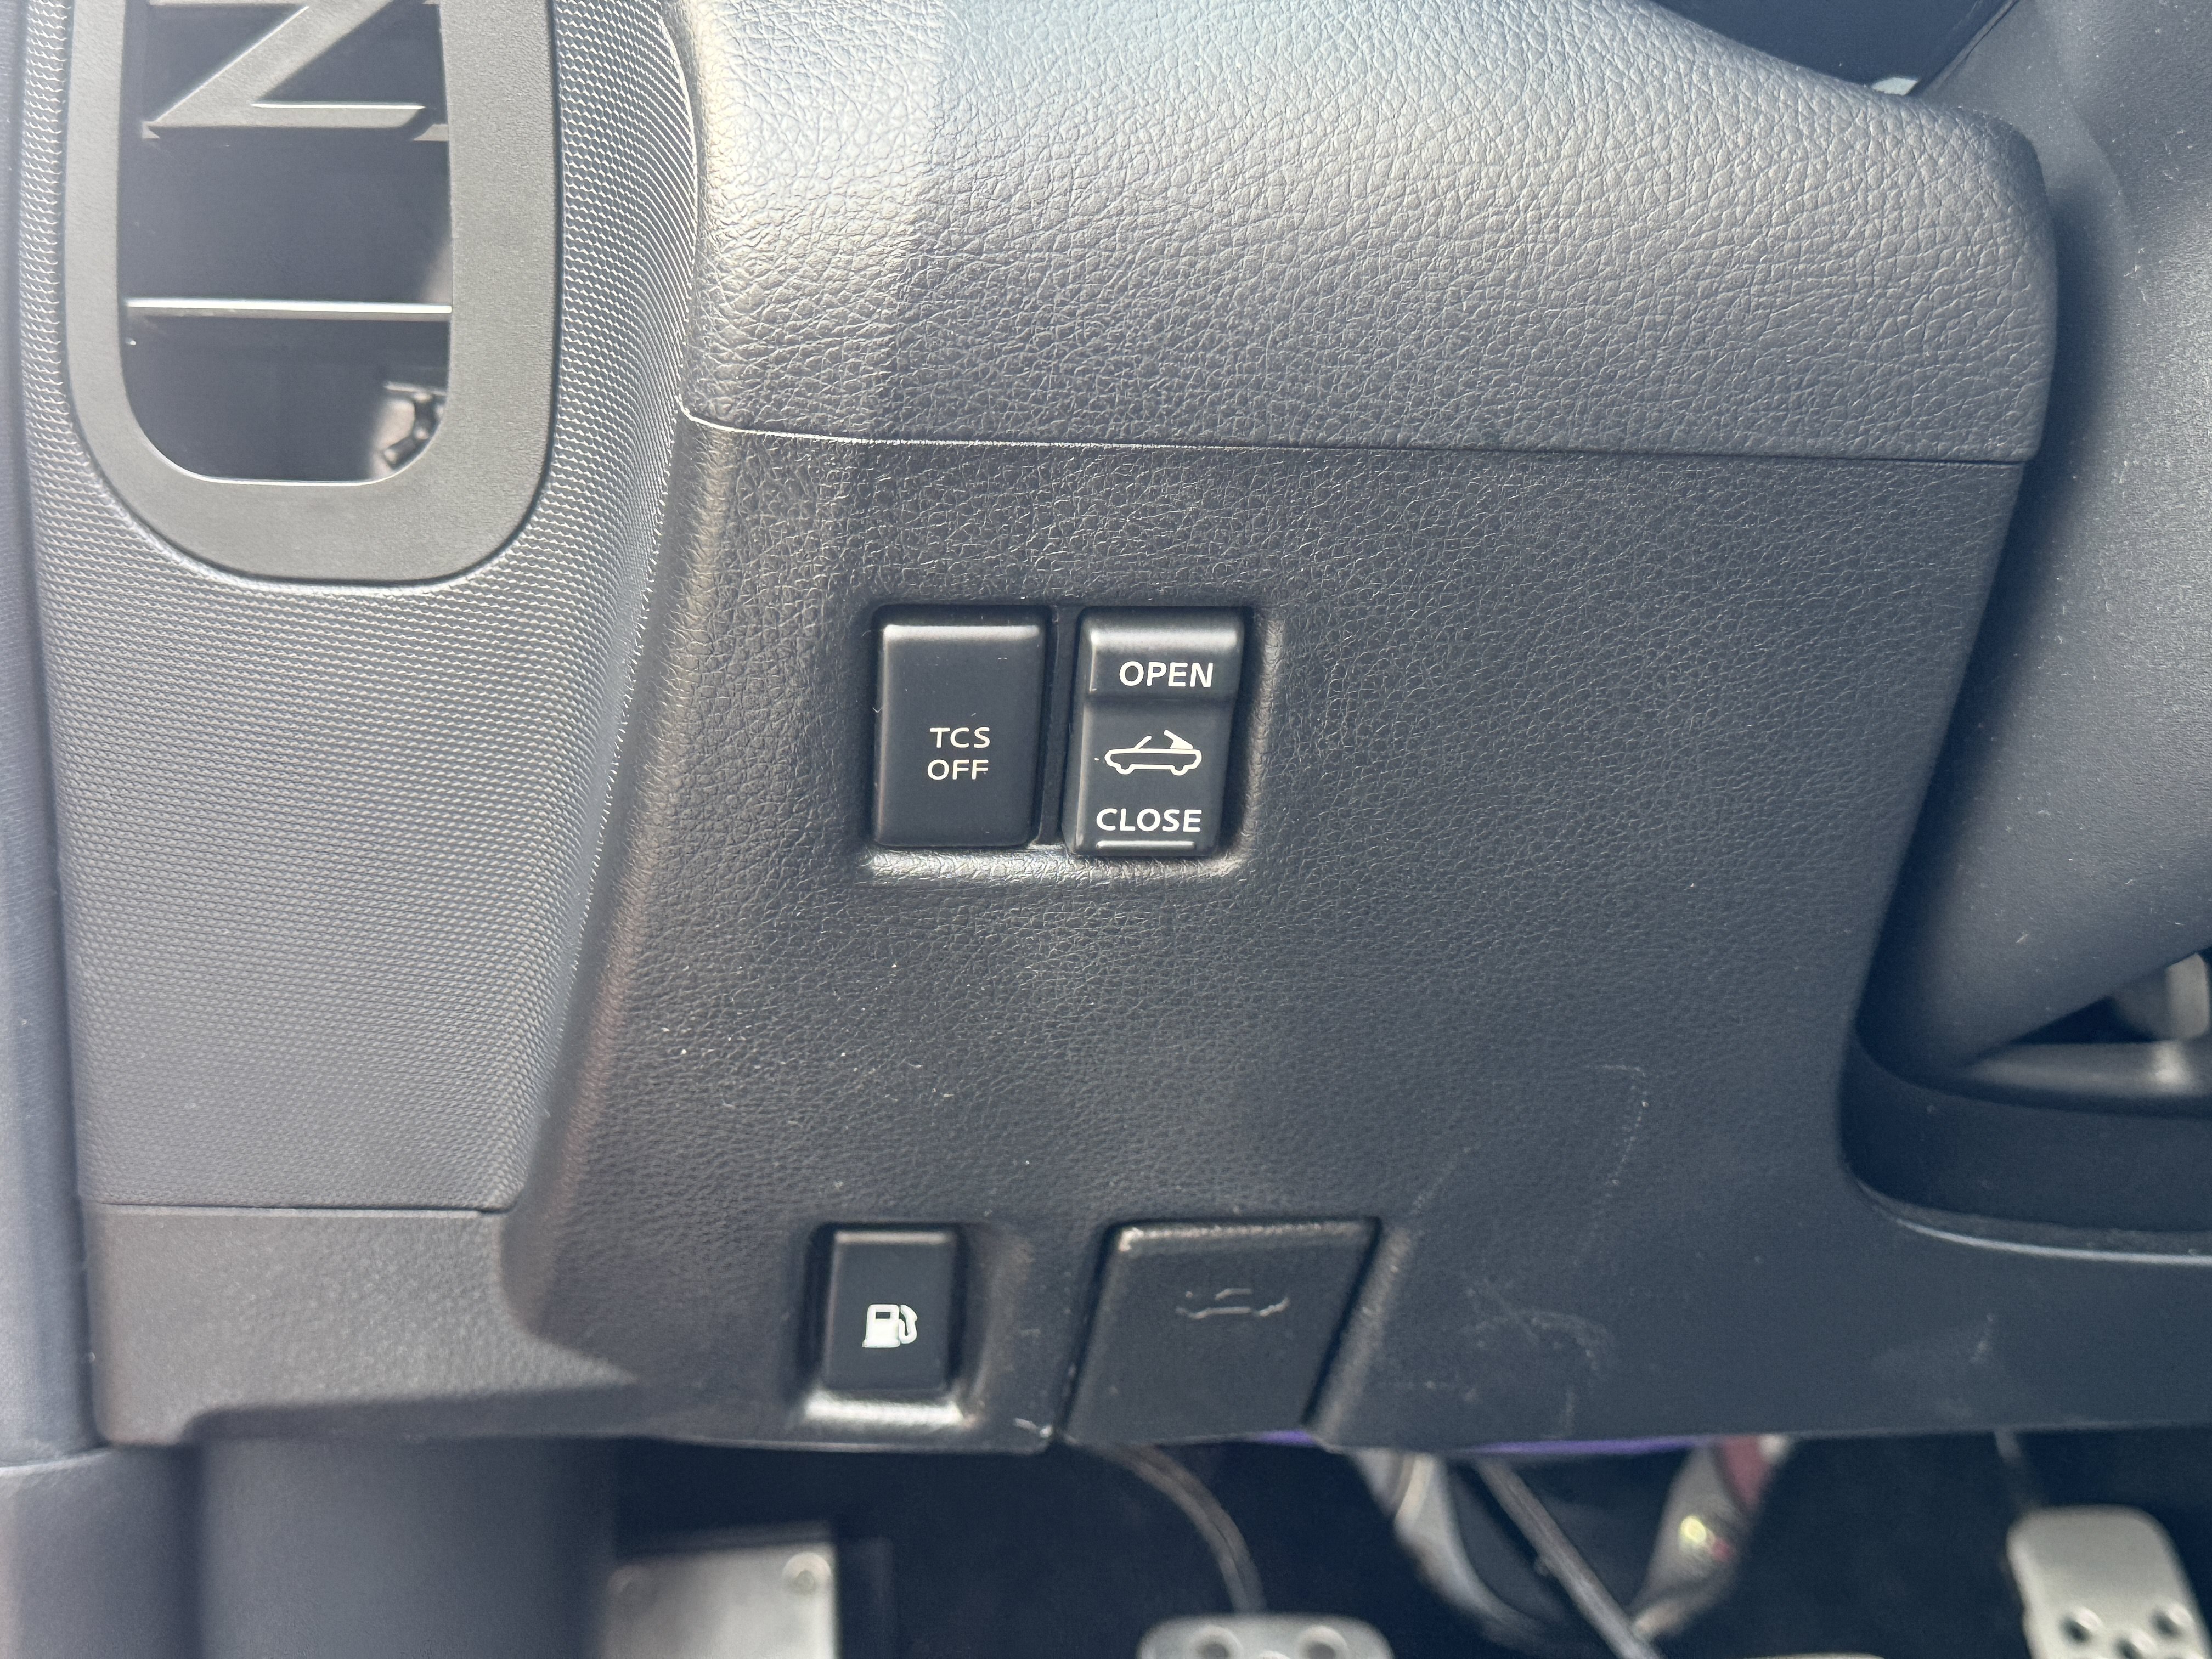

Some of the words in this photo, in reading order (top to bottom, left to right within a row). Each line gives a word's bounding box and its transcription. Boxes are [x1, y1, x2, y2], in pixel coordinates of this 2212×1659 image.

[1119, 661, 1214, 687] OPEN
[929, 727, 991, 748] TCS
[927, 759, 989, 780] OFF
[1096, 808, 1203, 833] CLOSE
